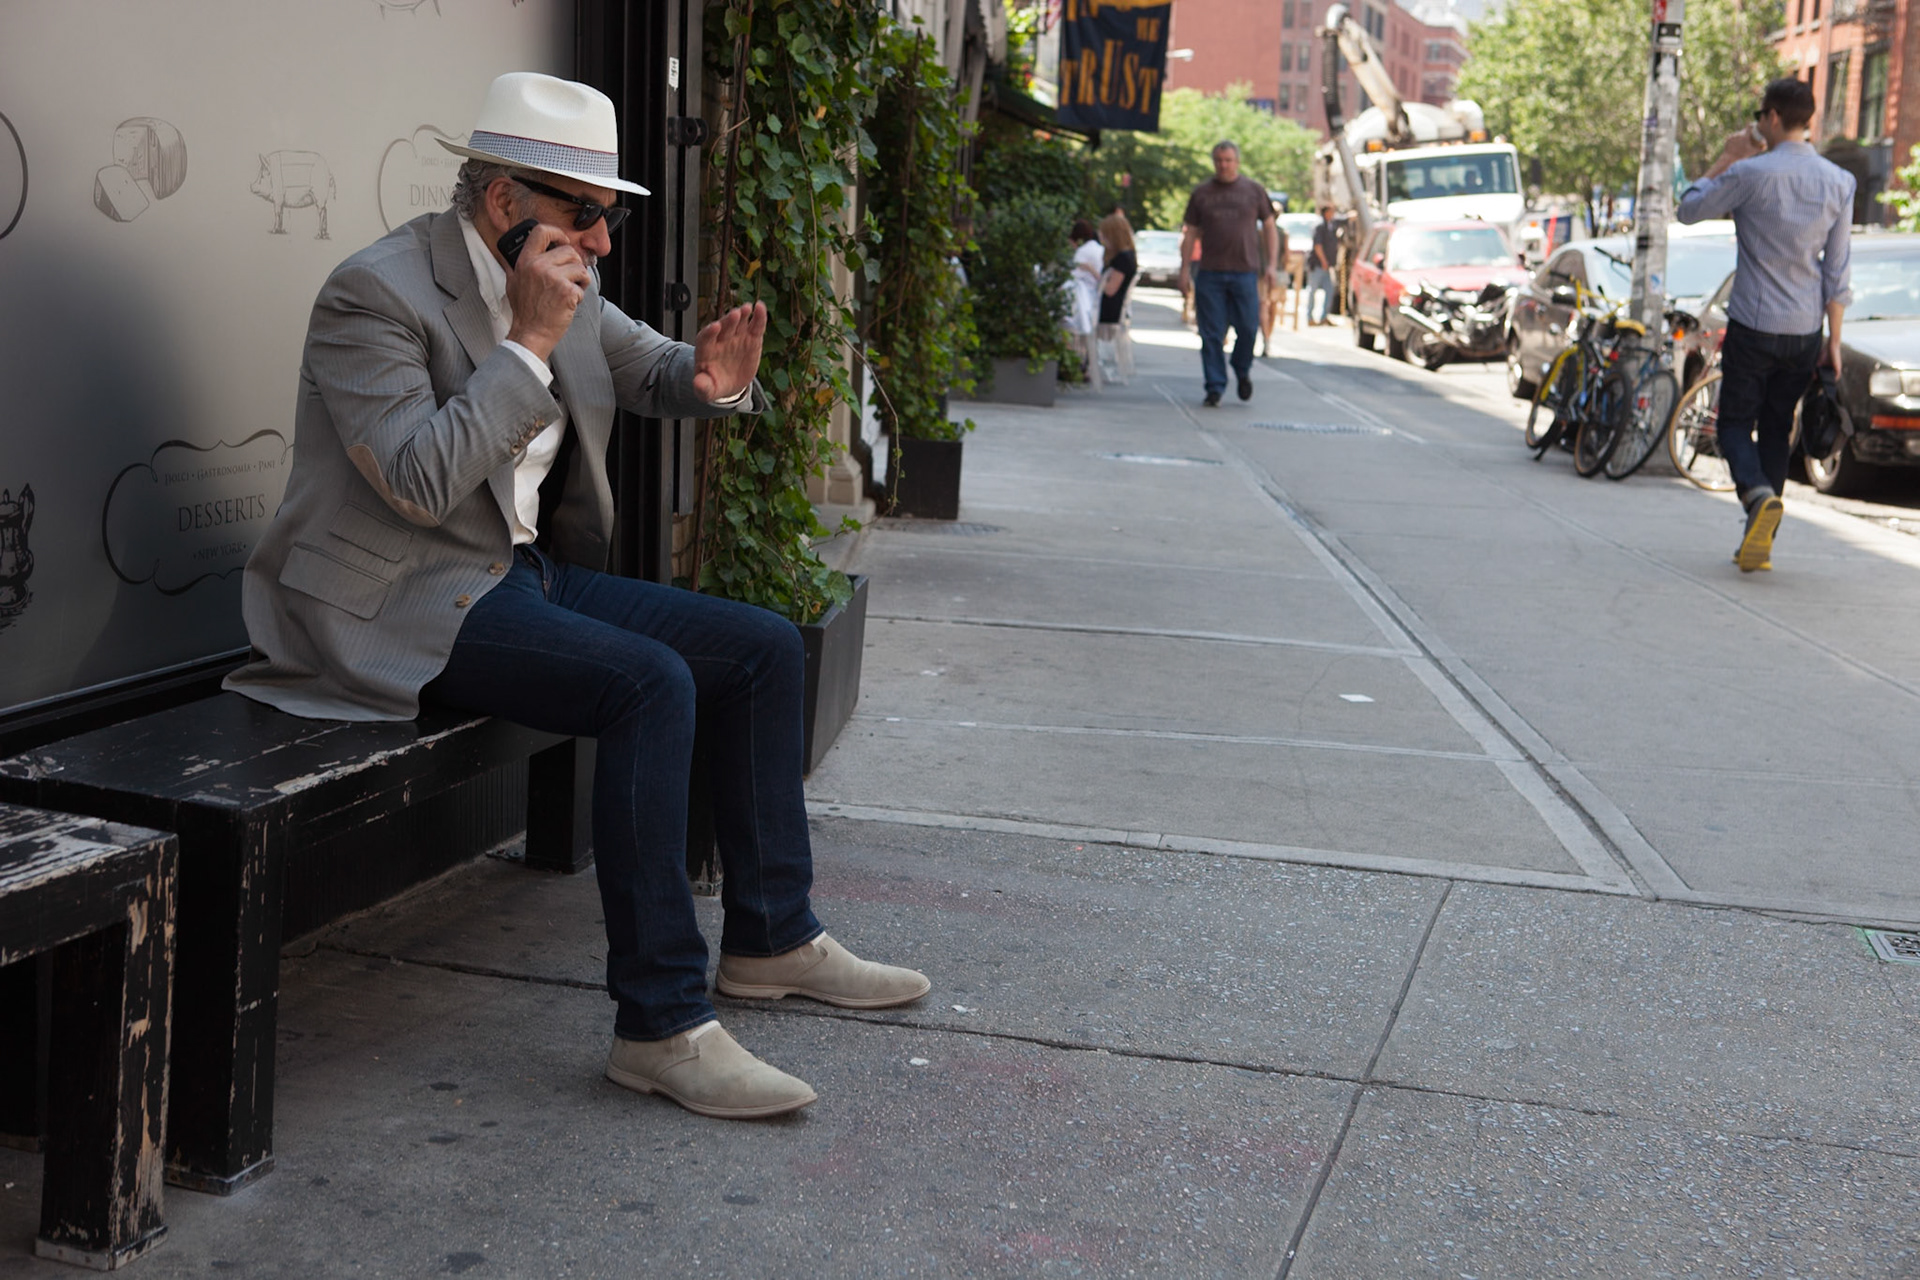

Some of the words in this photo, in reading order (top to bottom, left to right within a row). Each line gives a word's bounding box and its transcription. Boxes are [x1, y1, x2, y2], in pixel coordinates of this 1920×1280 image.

[1060, 39, 1159, 114] TRUST
[410, 184, 451, 207] DINN
[178, 494, 265, 532] DESSERTS
[198, 546, 219, 559] NEW
[220, 542, 242, 555] YORK
